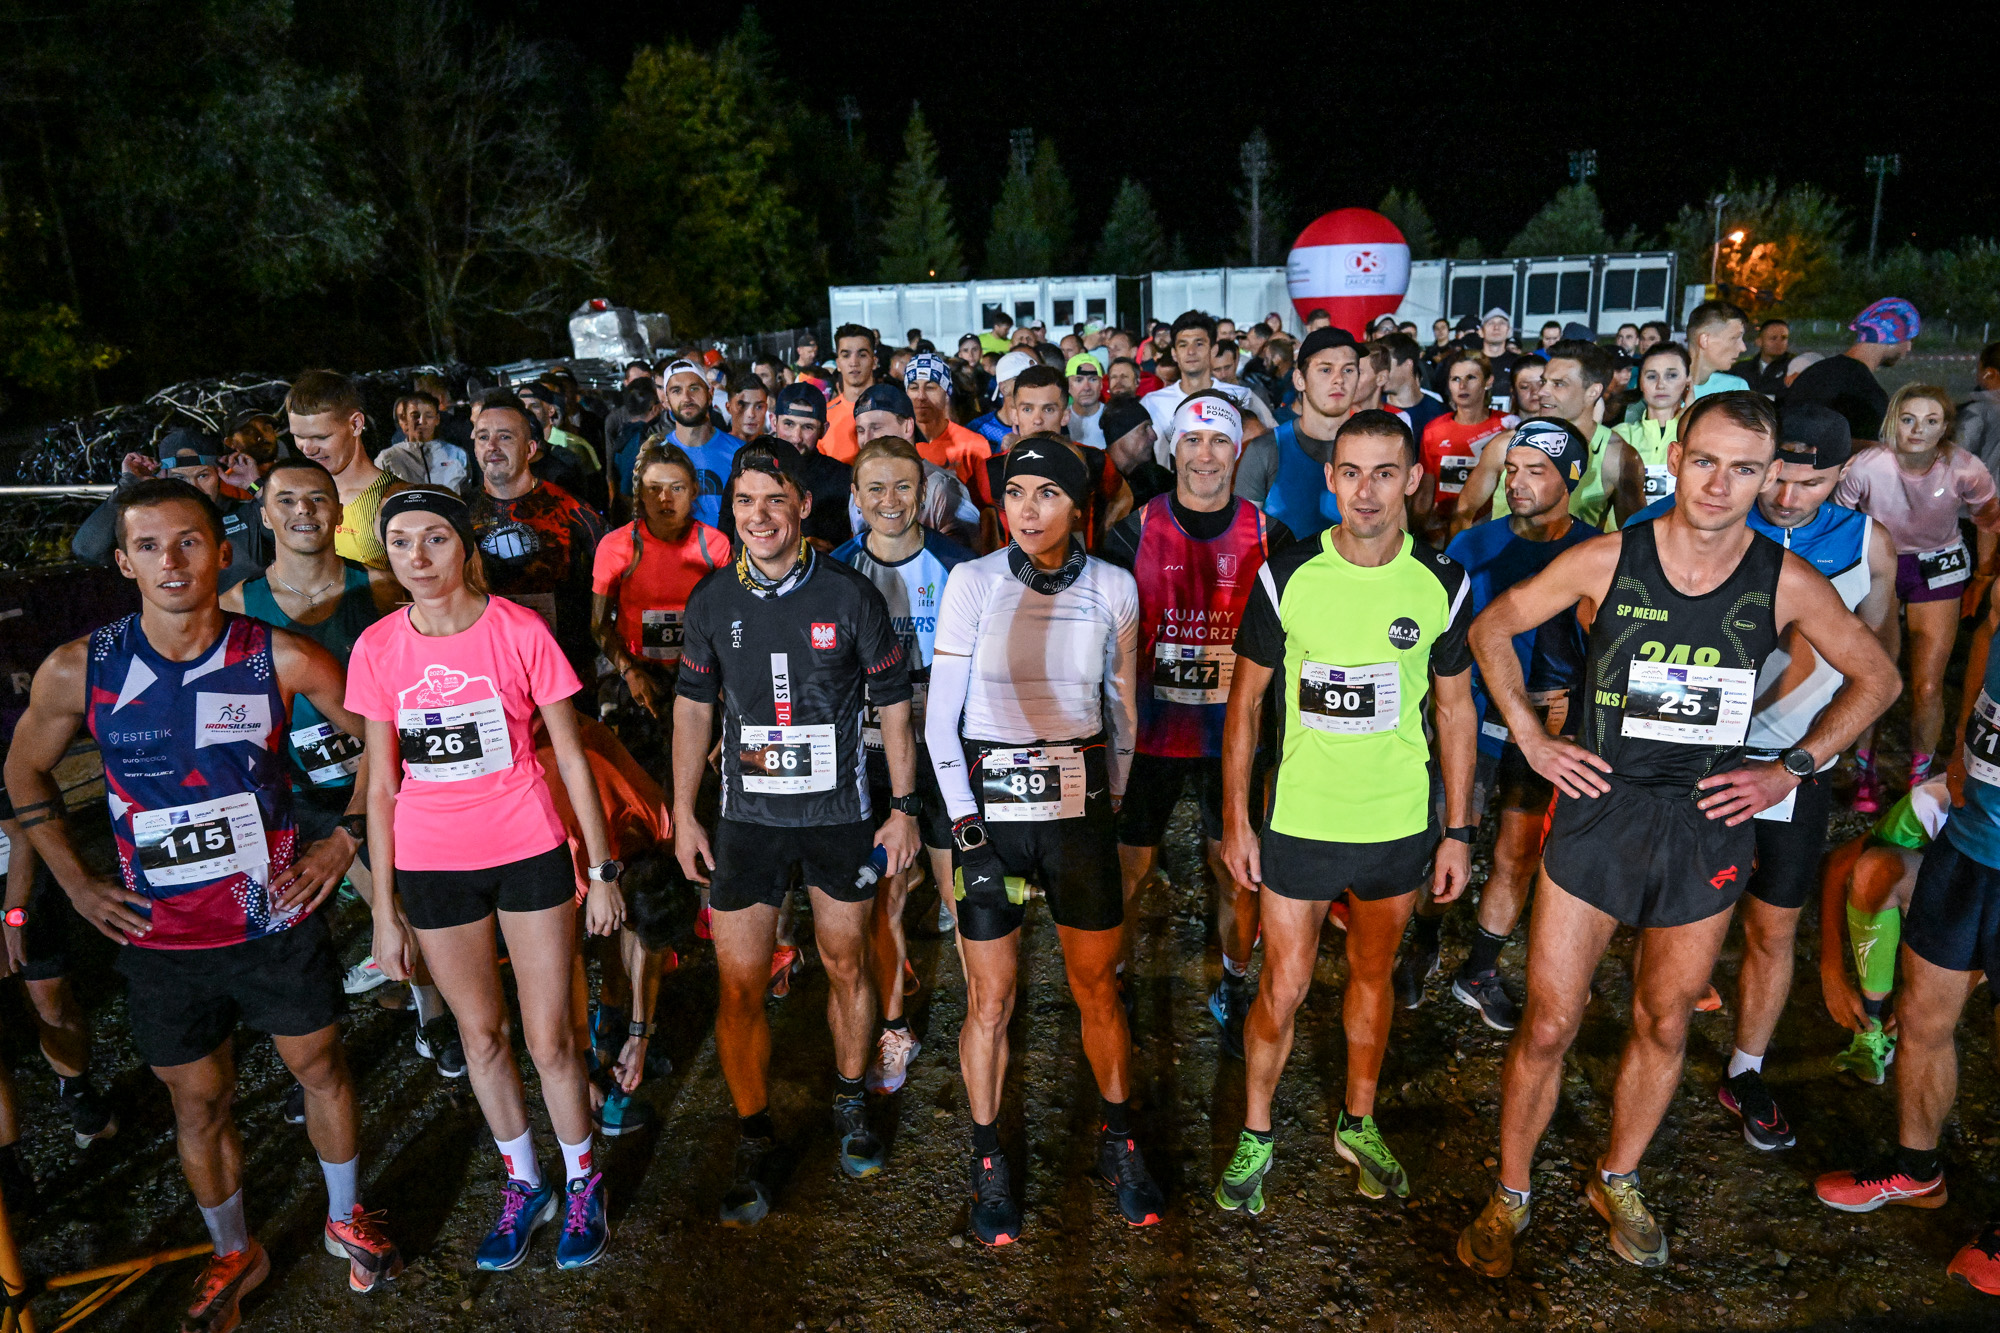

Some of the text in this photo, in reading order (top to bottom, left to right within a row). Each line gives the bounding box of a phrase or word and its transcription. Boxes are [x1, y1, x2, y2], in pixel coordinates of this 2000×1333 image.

[1206, 405, 1233, 418] KUJAWY
[1206, 410, 1236, 428] POMORZE
[1643, 479, 1658, 492] 9
[1938, 554, 1960, 571] 24
[1164, 608, 1234, 623] KUJAWY
[1616, 604, 1669, 622] SP MEDIA
[661, 628, 685, 643] 87
[1157, 624, 1238, 640] POMORZE
[1639, 640, 1721, 668] 248
[1170, 665, 1215, 683] 147
[1324, 690, 1361, 711] 90
[1595, 689, 1621, 708] UKS
[1657, 691, 1703, 717] 25
[122, 729, 172, 743] ESTETIK
[425, 733, 465, 756] 26
[316, 736, 362, 761] 111
[764, 750, 798, 770] 86
[1010, 773, 1046, 795] 89
[160, 826, 227, 859] 115
